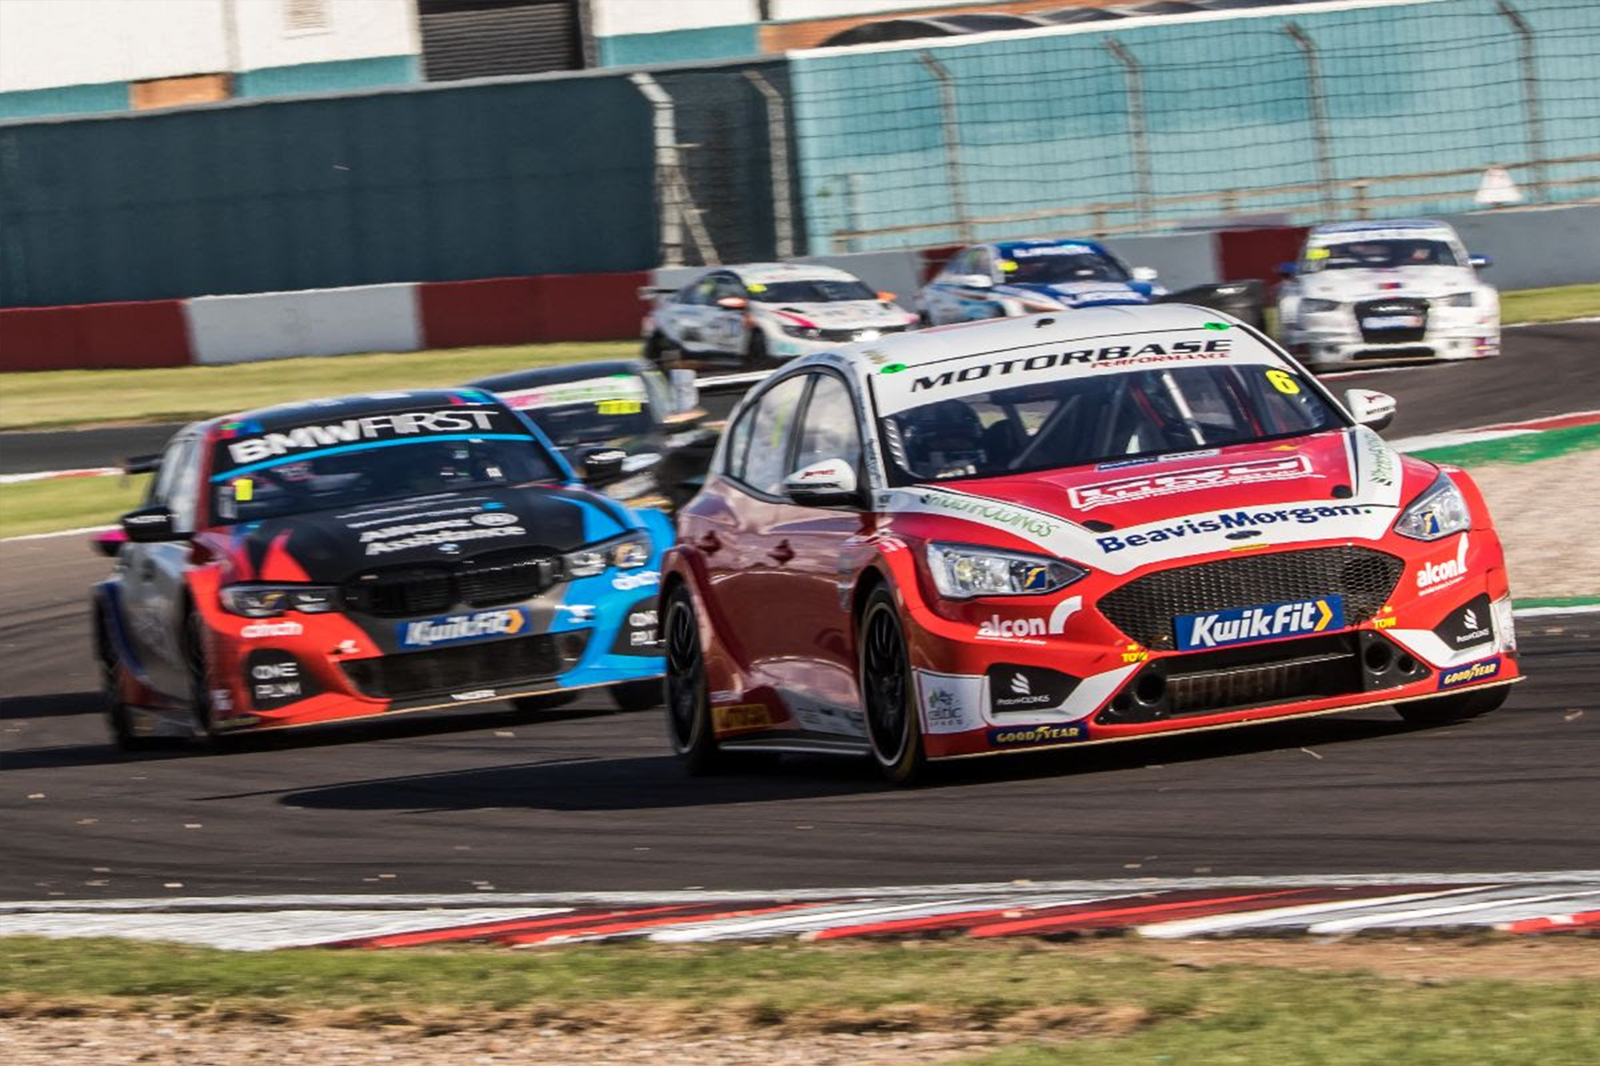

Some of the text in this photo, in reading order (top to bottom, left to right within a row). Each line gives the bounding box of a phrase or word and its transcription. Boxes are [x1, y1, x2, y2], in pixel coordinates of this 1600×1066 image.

[911, 339, 1233, 392] MOTORBASE
[1090, 352, 1230, 369] PERFORMANCE
[1265, 369, 1300, 395] 6
[1416, 559, 1458, 588] alcon
[977, 614, 1047, 638] alcon
[1372, 617, 1397, 630] TOW
[1444, 663, 1497, 685] GOODYEAR
[996, 726, 1079, 743] GOODYEAR
